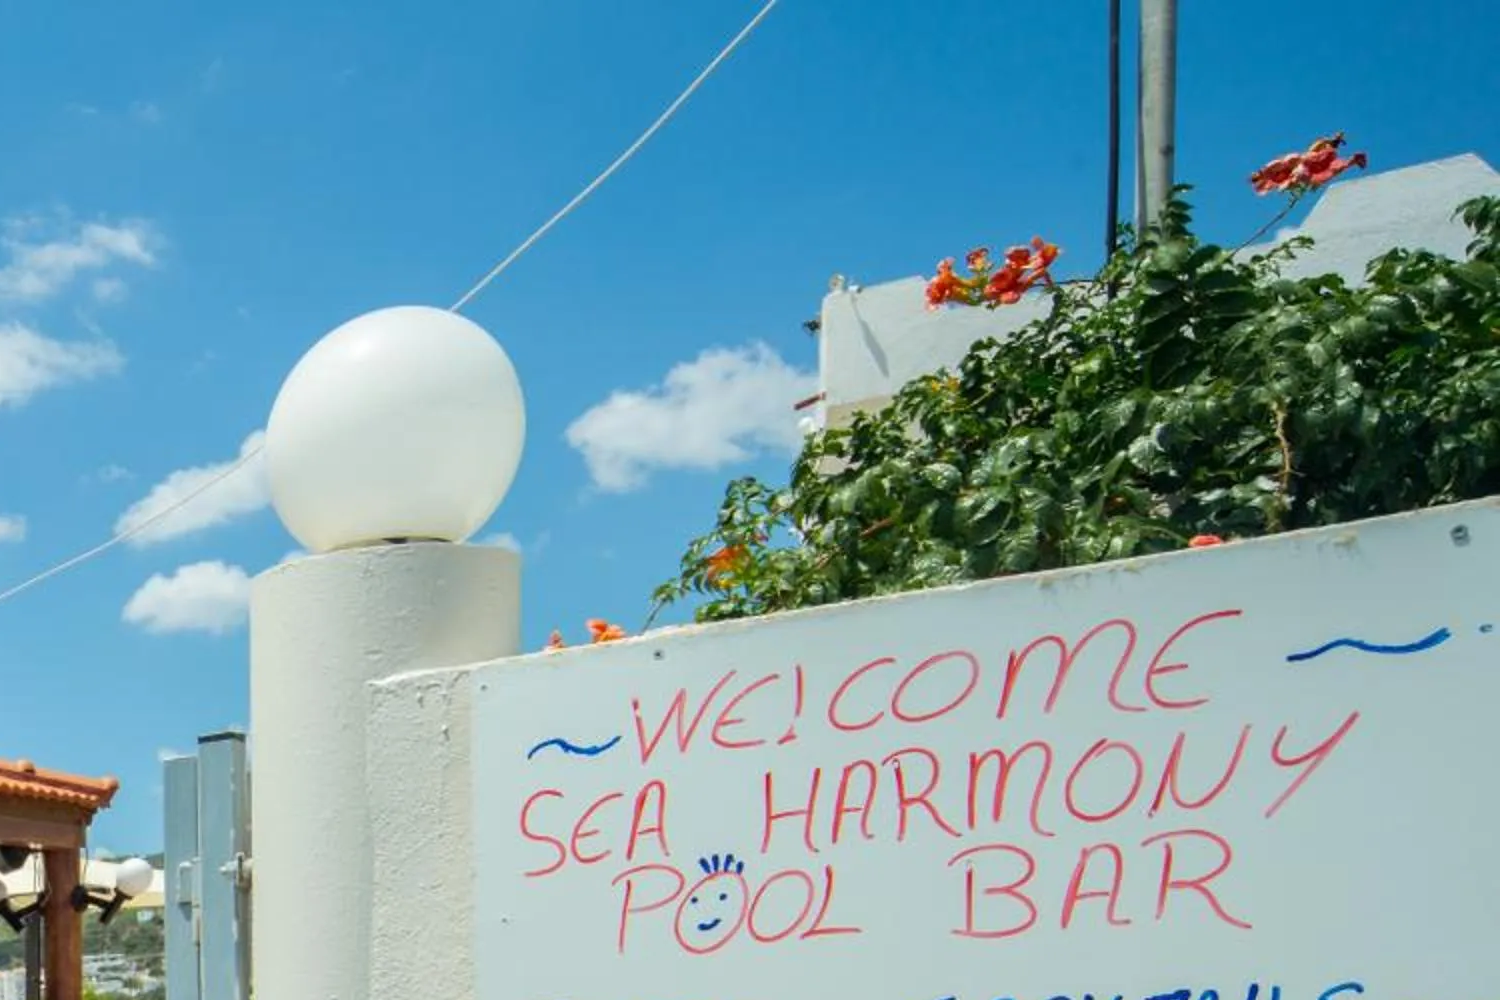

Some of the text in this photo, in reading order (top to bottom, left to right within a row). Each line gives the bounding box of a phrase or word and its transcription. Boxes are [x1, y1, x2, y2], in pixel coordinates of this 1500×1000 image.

[519, 710, 1359, 877] SEA HARMONY
[611, 828, 1253, 954] POOL BAR
